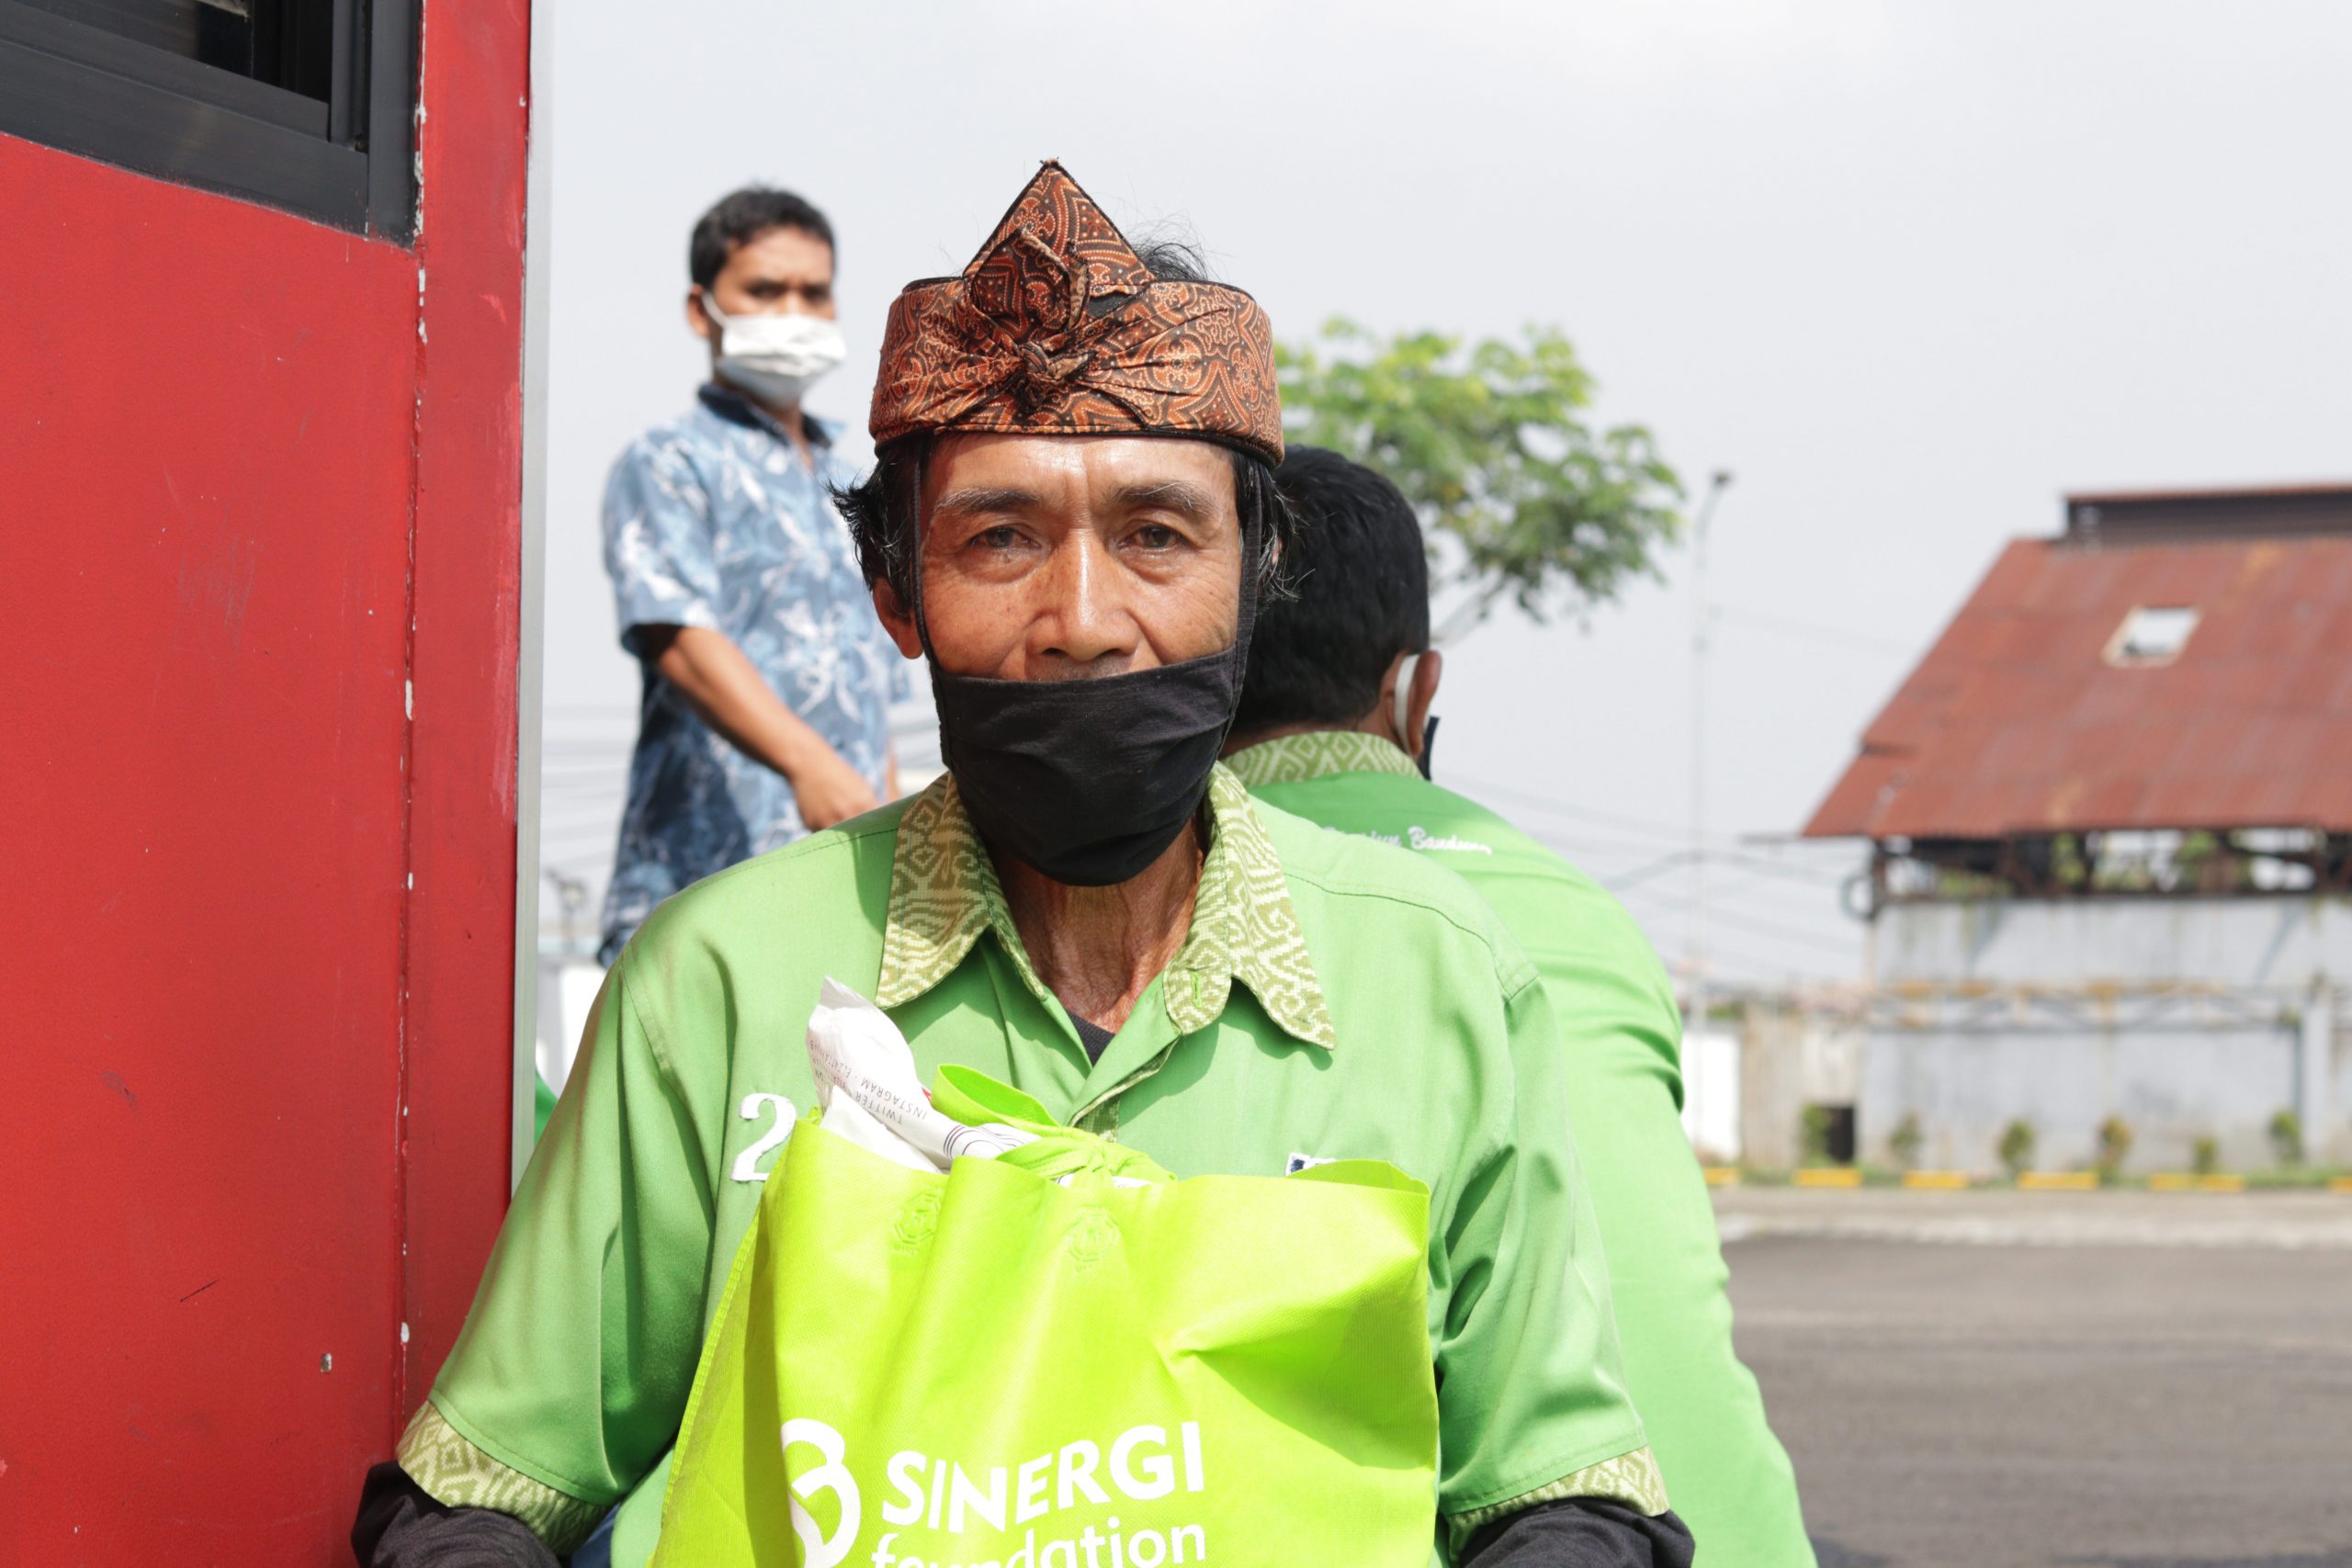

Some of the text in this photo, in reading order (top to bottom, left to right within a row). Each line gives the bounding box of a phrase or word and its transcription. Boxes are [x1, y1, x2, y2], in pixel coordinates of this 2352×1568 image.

[855, 1090, 902, 1125] TWITTER
[861, 1077, 928, 1120] INSTAGRAM
[730, 1093, 797, 1182] 2
[881, 1421, 1204, 1533] SINERGI
[871, 1517, 1206, 1568] fdation
